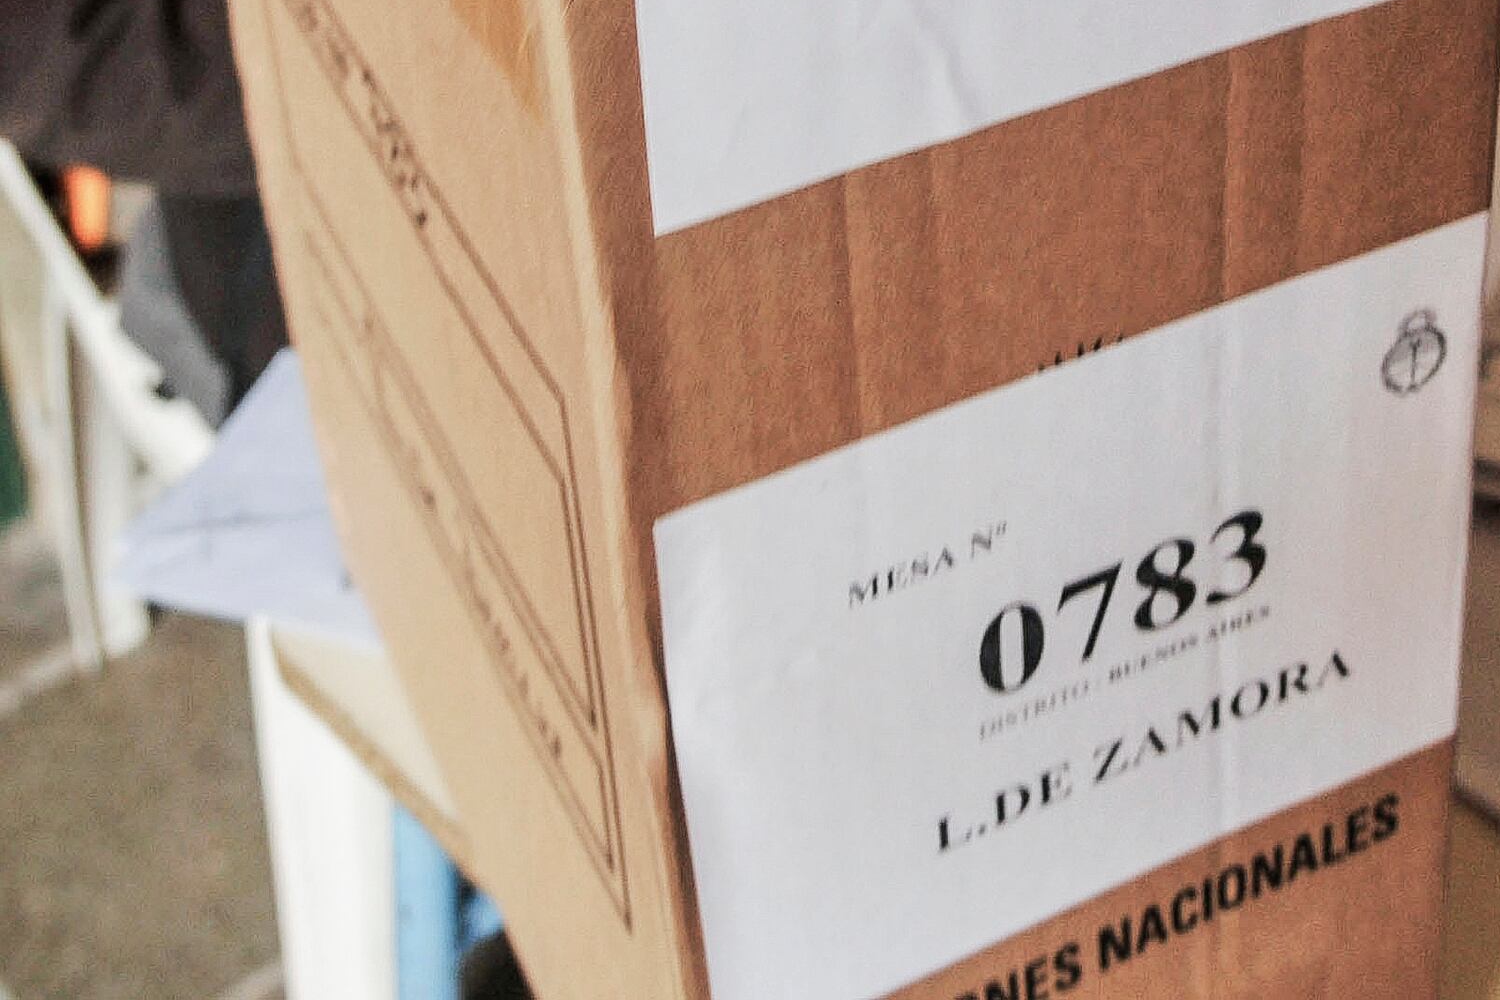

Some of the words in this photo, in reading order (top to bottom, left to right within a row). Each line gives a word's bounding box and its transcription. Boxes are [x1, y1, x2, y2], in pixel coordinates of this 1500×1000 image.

[848, 546, 955, 608] MESA
[978, 510, 1267, 694] 0783
[1093, 648, 1352, 783] ZAMORA
[1098, 793, 1400, 972] NACIONALES
